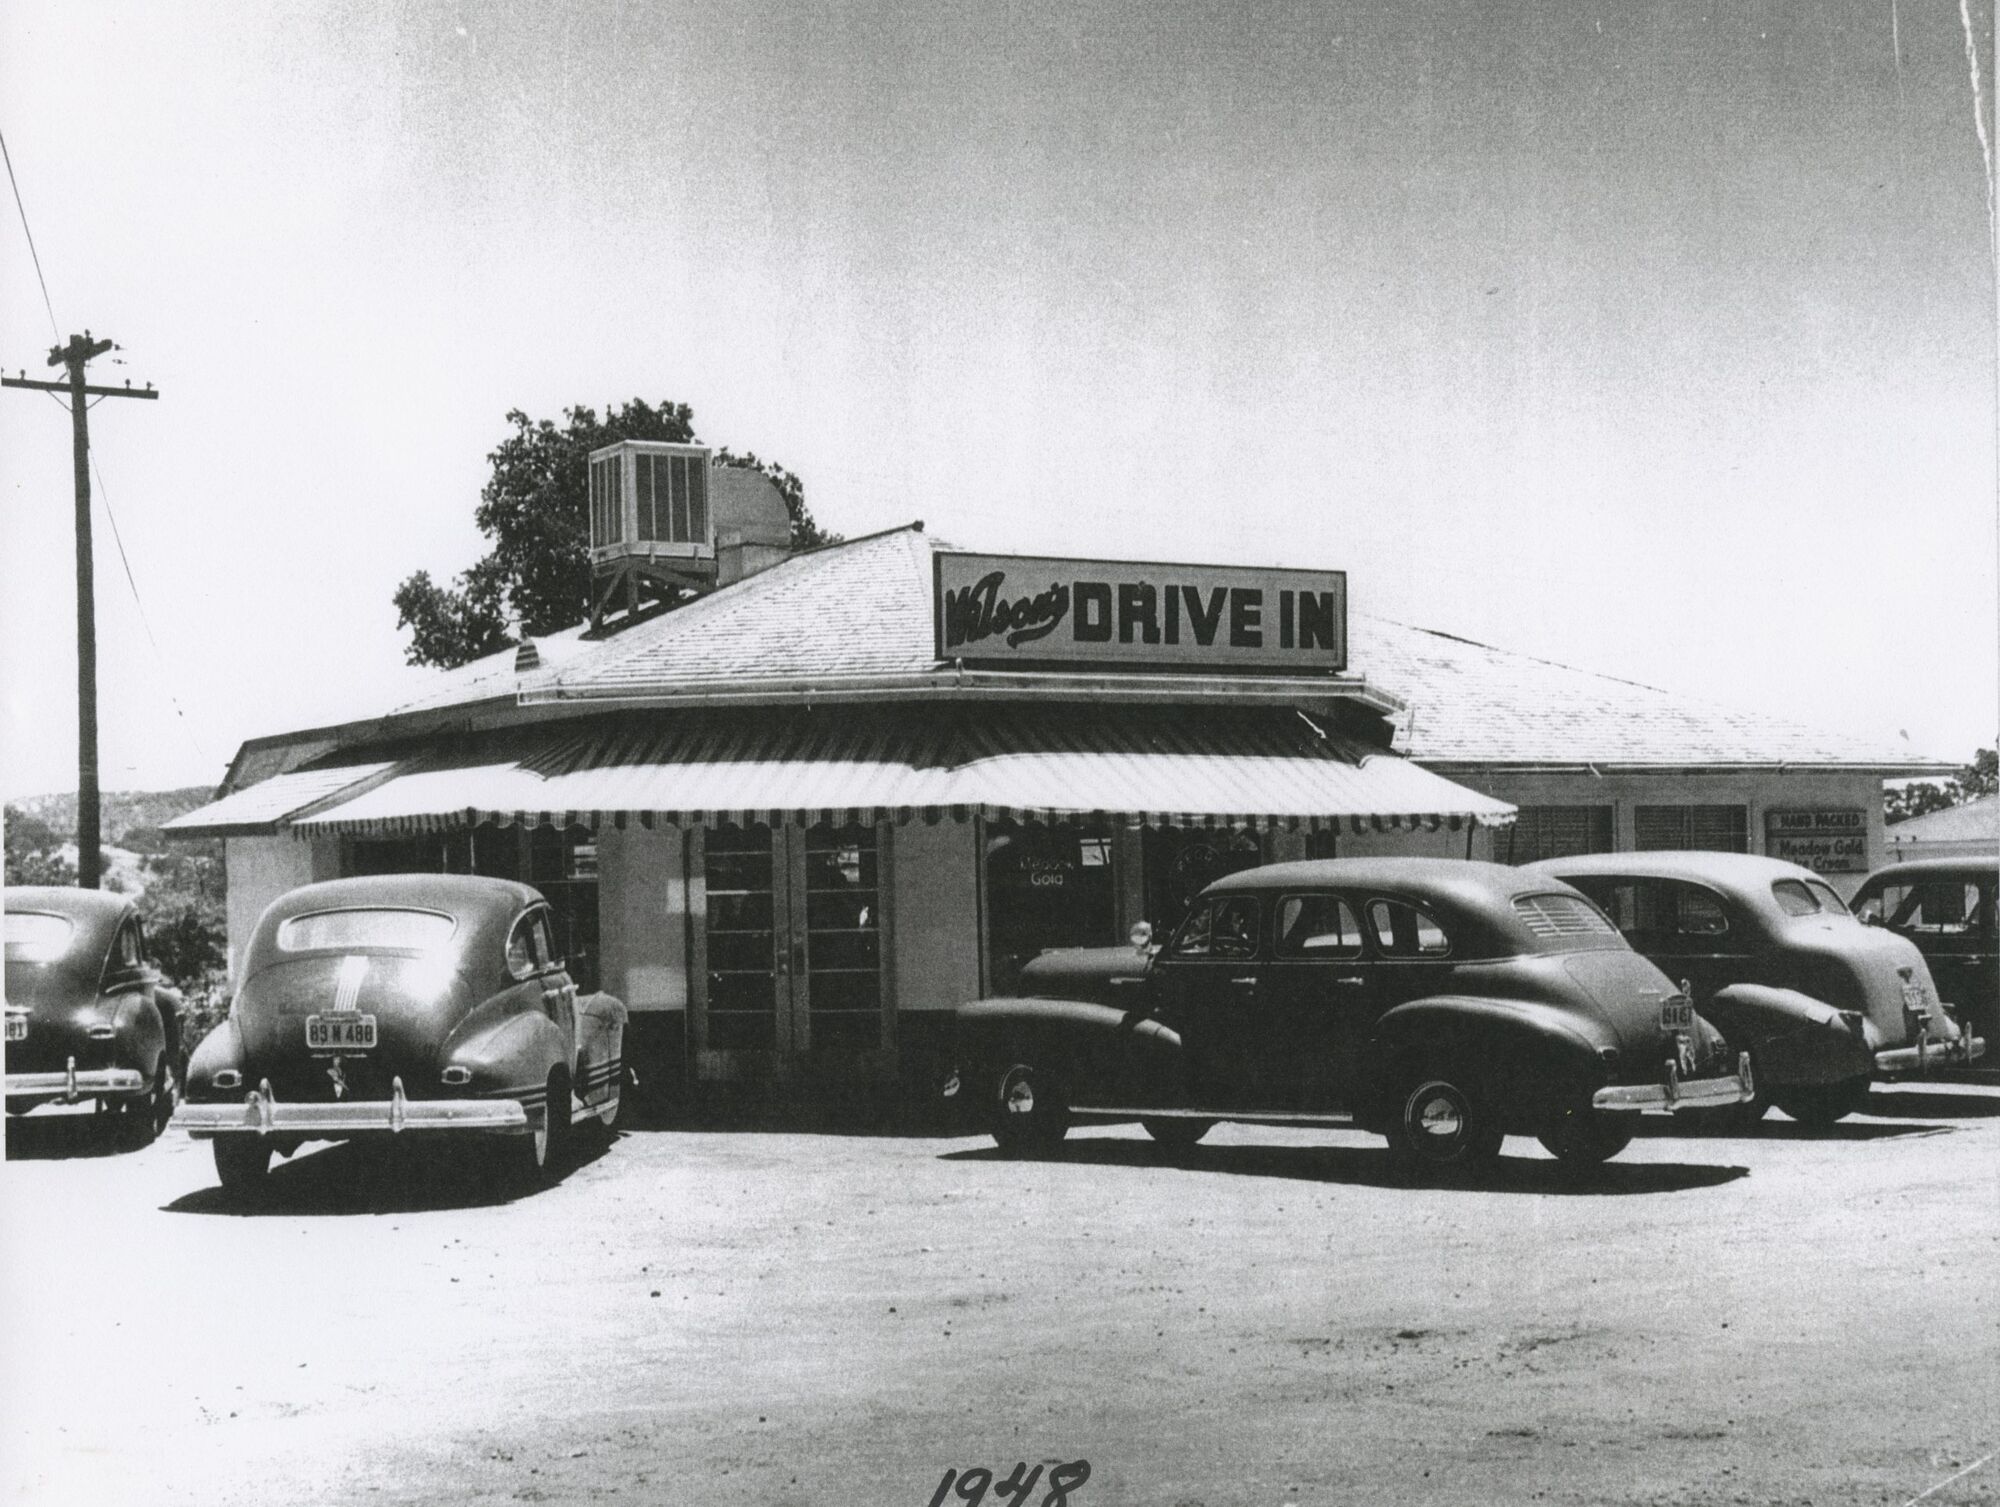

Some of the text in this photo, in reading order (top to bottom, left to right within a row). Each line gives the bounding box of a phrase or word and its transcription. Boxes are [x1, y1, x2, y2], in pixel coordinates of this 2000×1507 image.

[1073, 581, 1263, 648] DRIVE
[1280, 590, 1334, 650] IN
[1780, 838, 1864, 856] Meadow Gold
[928, 1459, 1091, 1507] 1948
